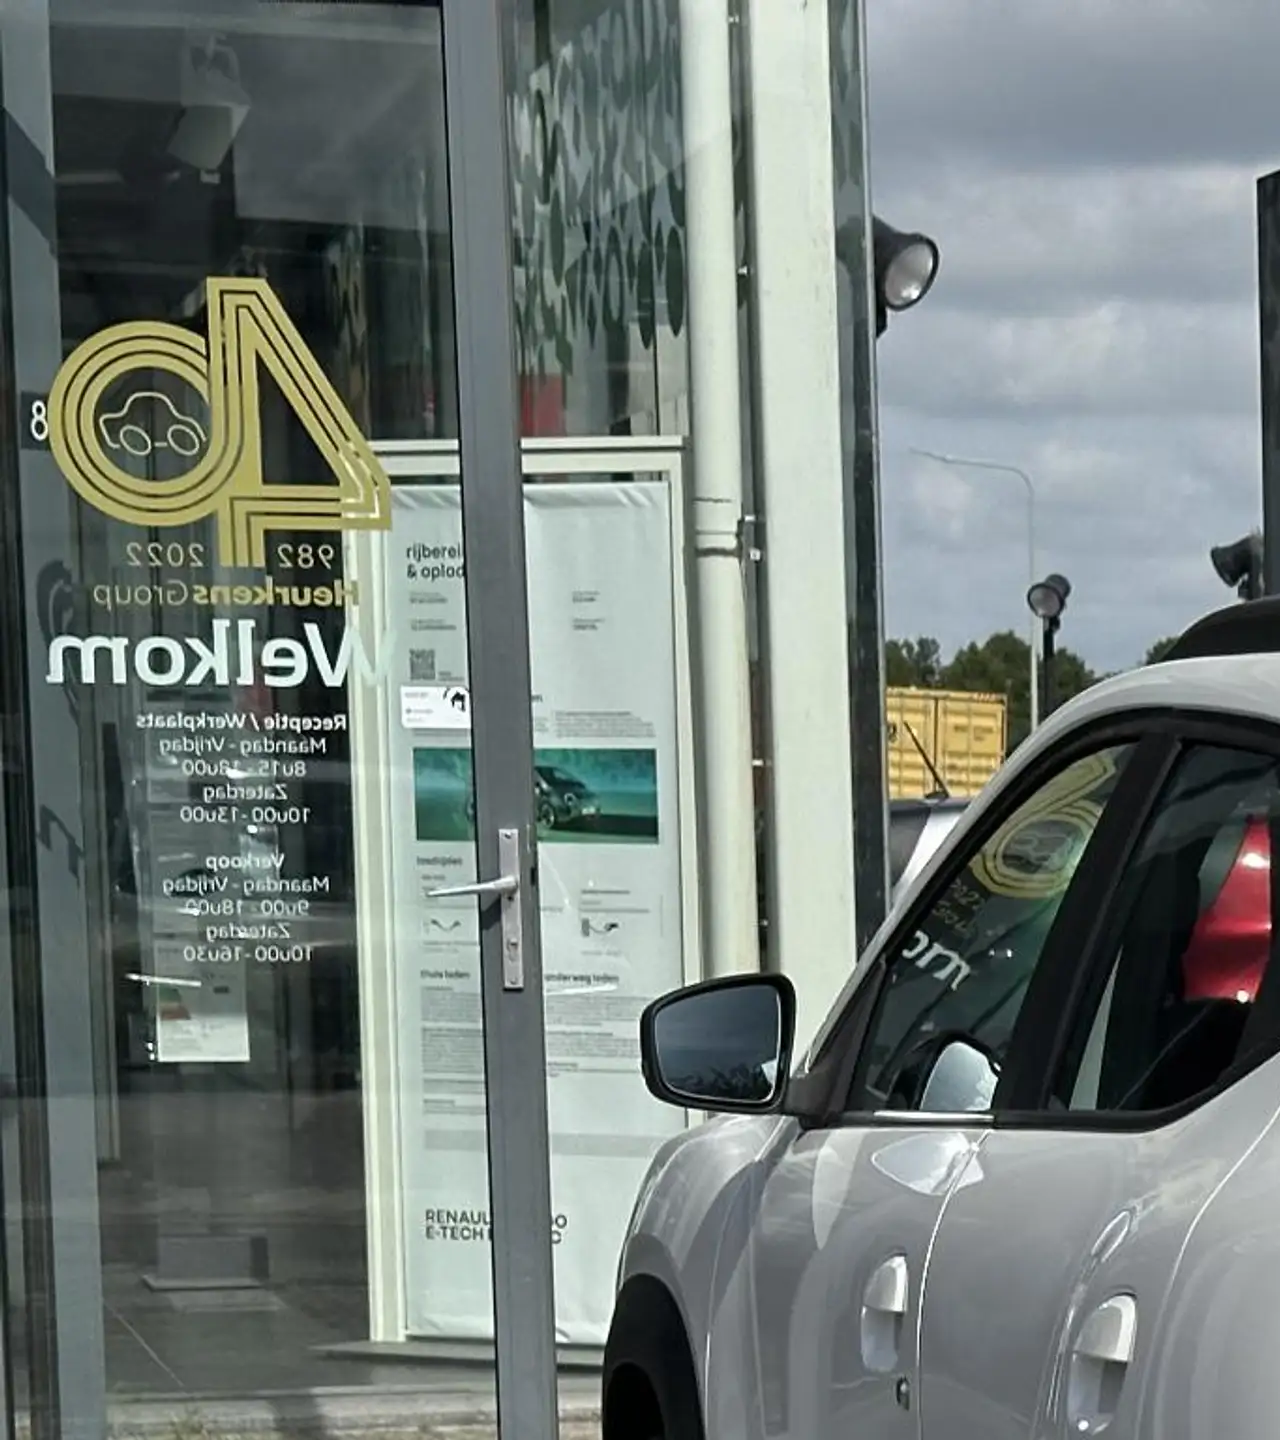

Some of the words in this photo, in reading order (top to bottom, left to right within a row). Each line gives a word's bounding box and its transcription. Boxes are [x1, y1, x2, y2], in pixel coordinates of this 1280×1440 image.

[31, 400, 49, 441] 8
[406, 542, 462, 563] rijberei
[425, 1209, 493, 1226] RENAUL
[425, 1226, 485, 1241] E-TECH
